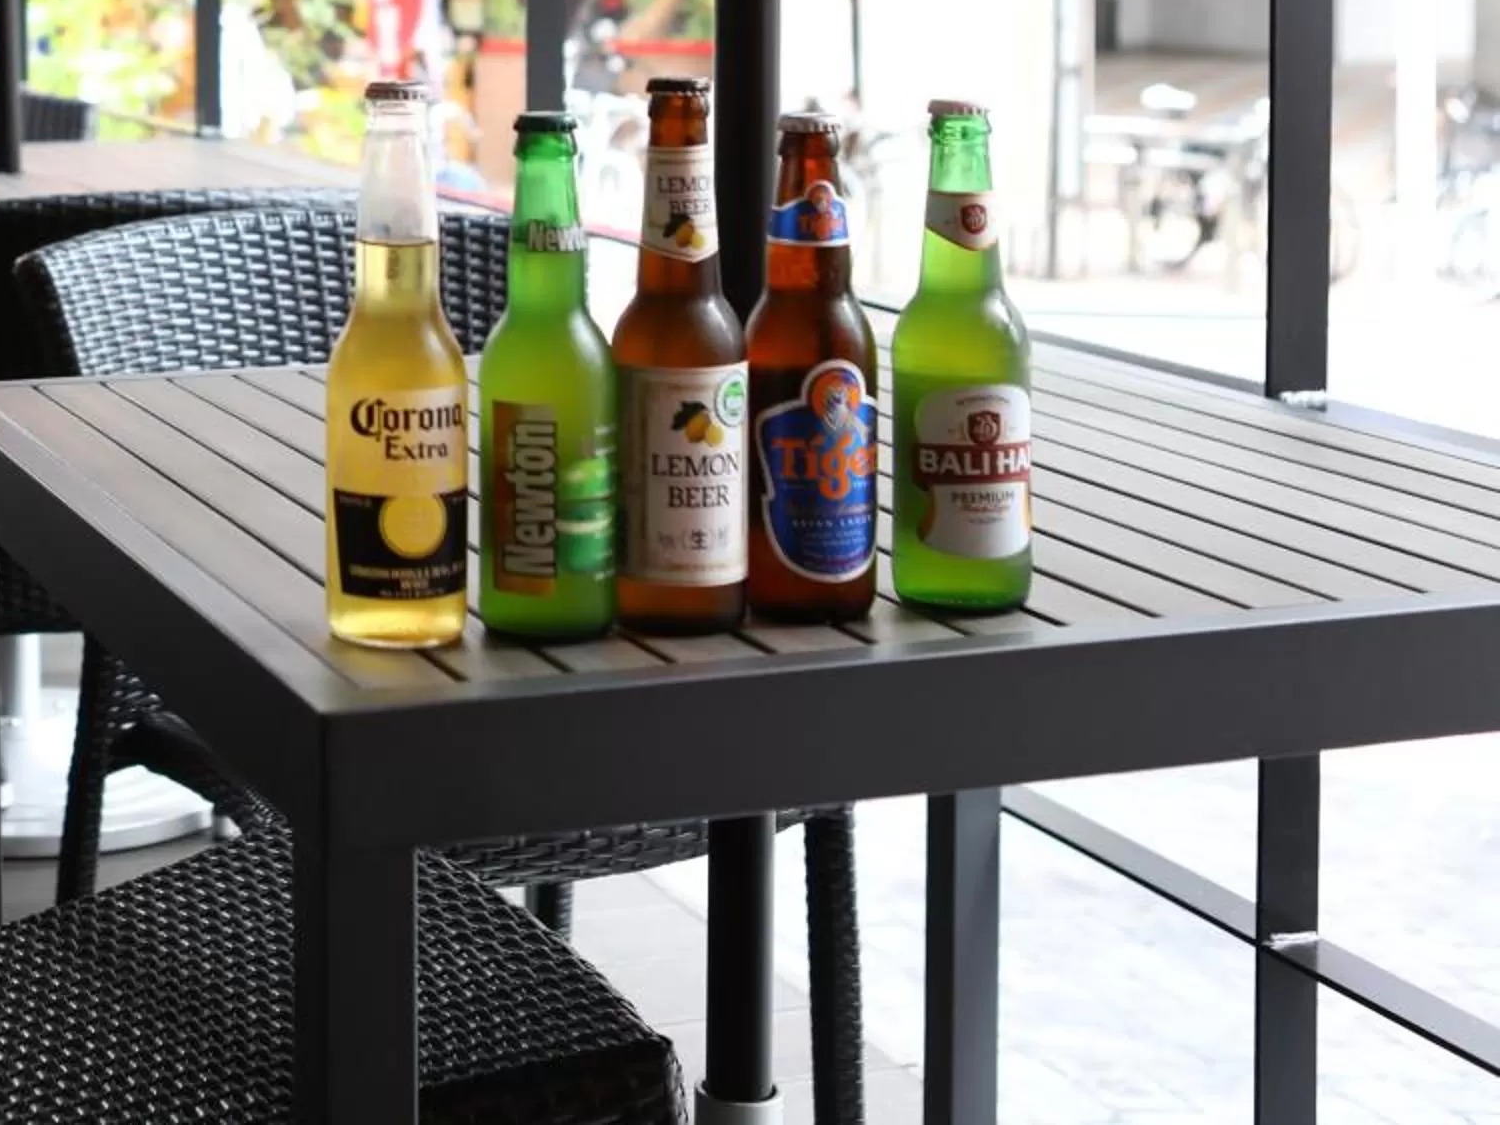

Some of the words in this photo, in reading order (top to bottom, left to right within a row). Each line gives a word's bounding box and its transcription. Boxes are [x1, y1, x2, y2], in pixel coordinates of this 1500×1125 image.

[350, 396, 466, 443] Corona
[384, 434, 449, 461] Extra
[918, 447, 990, 476] BALI
[650, 450, 741, 477] LEMON
[503, 421, 557, 575] Newton
[667, 483, 731, 509] BEER
